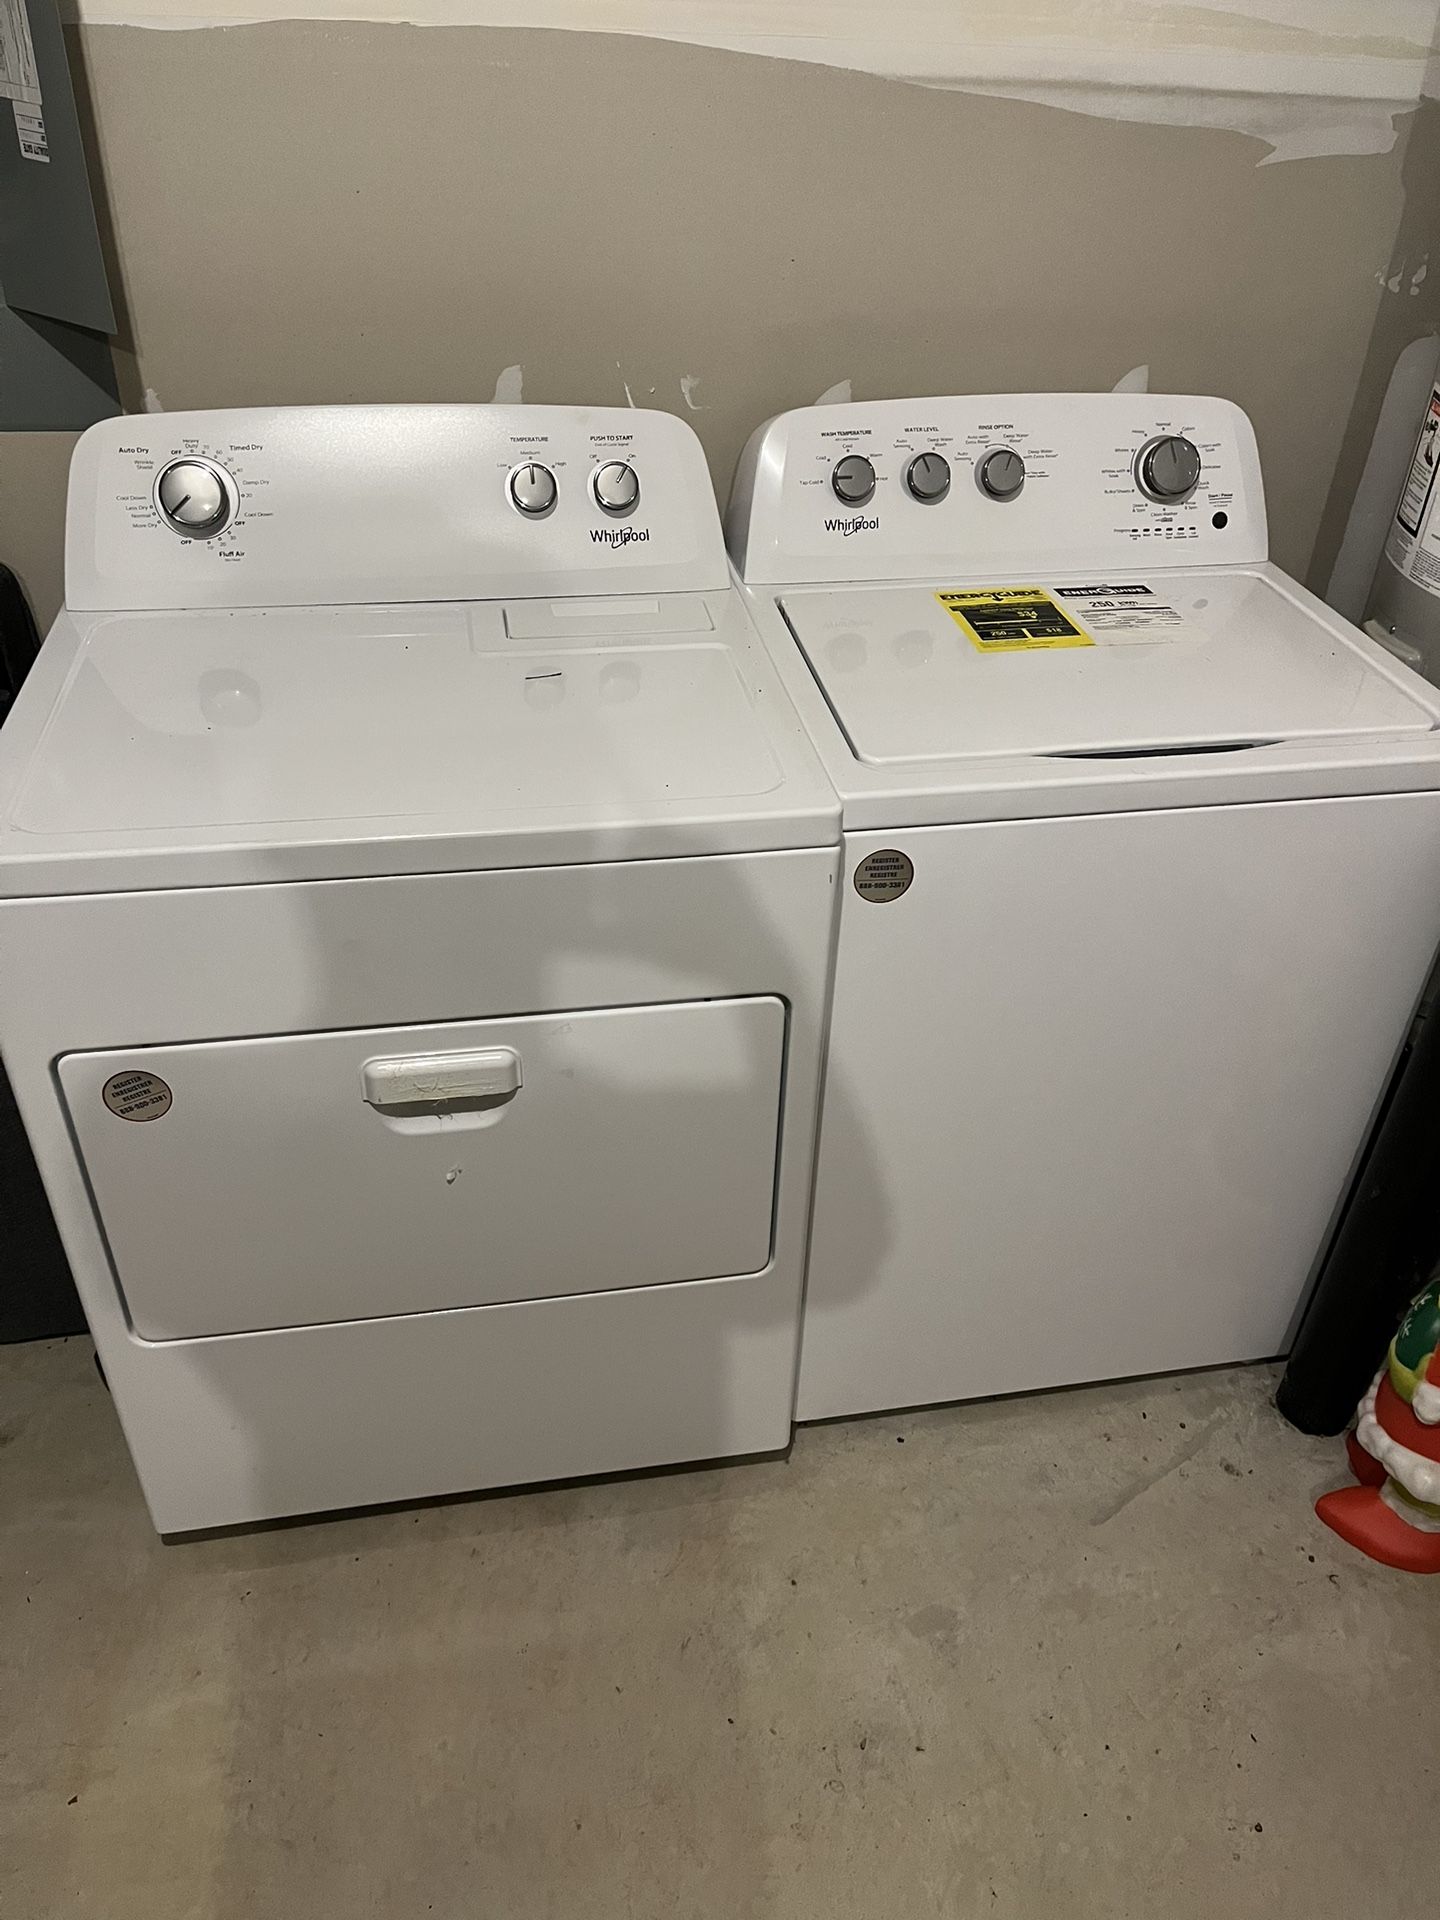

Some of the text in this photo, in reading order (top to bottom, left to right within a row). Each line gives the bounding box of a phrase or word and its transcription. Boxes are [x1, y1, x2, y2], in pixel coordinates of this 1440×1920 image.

[824, 516, 879, 536] Whirlpool
[590, 527, 650, 549] Whirlpool
[112, 1076, 142, 1090] REGISTER
[112, 1080, 153, 1098] ENREGISTRER
